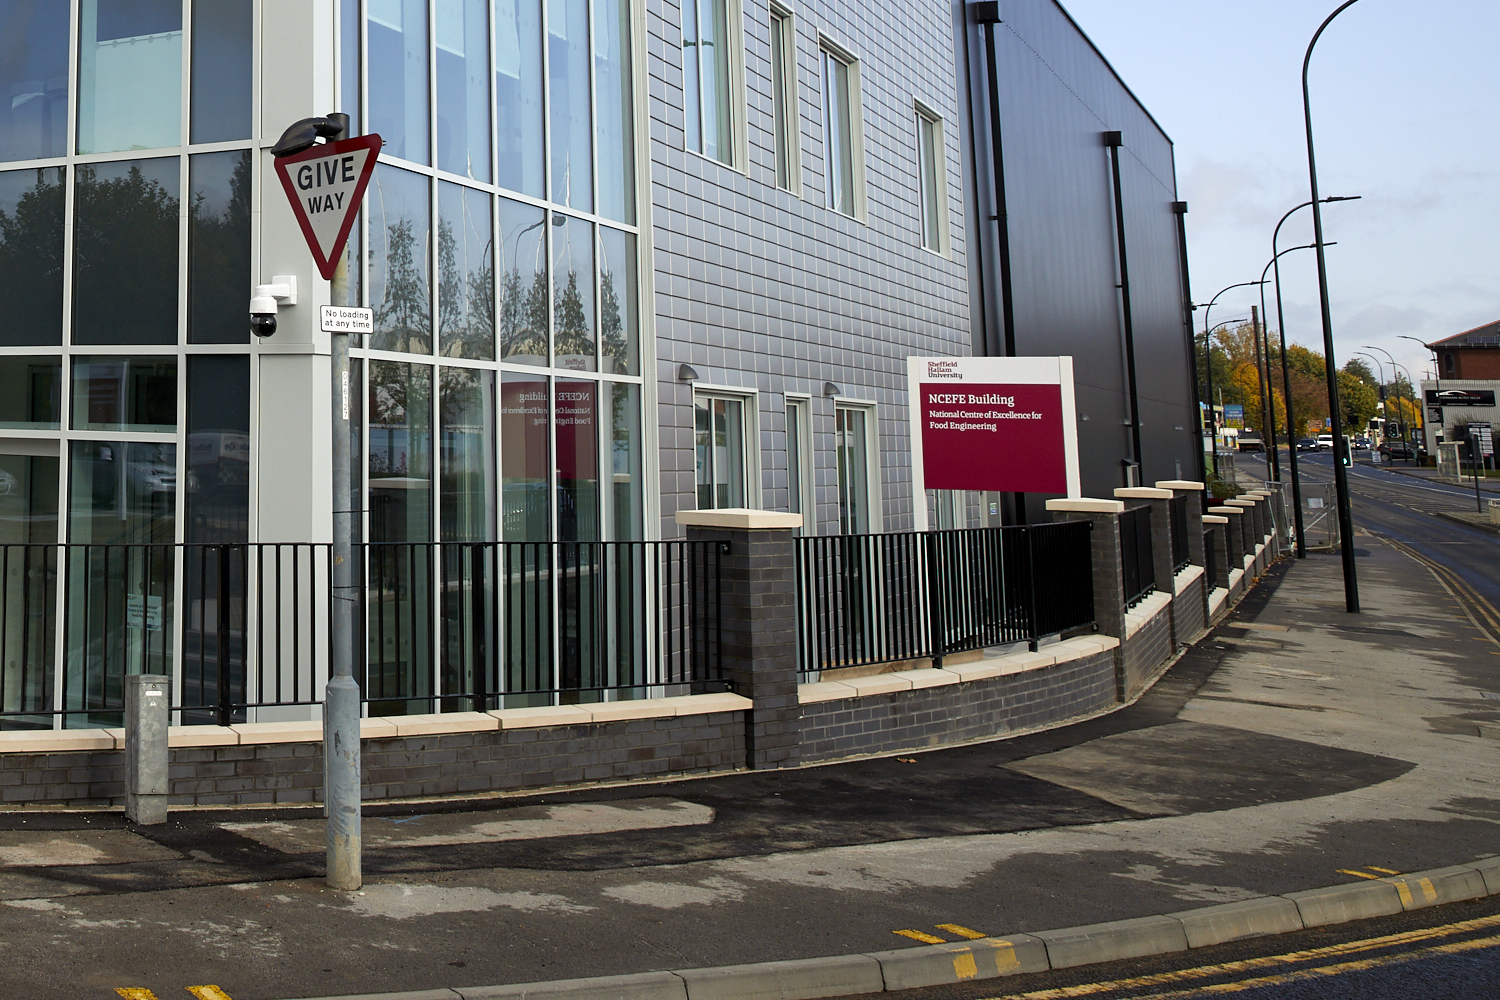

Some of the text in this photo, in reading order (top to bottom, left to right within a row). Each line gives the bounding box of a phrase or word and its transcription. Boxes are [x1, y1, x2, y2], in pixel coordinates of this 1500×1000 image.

[297, 156, 355, 190] GIVE
[308, 192, 344, 214] WAY
[325, 309, 369, 320] No loading
[335, 320, 350, 328] any
[352, 320, 370, 328] time
[928, 372, 963, 380] University
[929, 393, 1015, 407] NCEFE Building
[929, 410, 1042, 420] National Centre of Excellence for
[929, 421, 997, 432] Food Engineering
